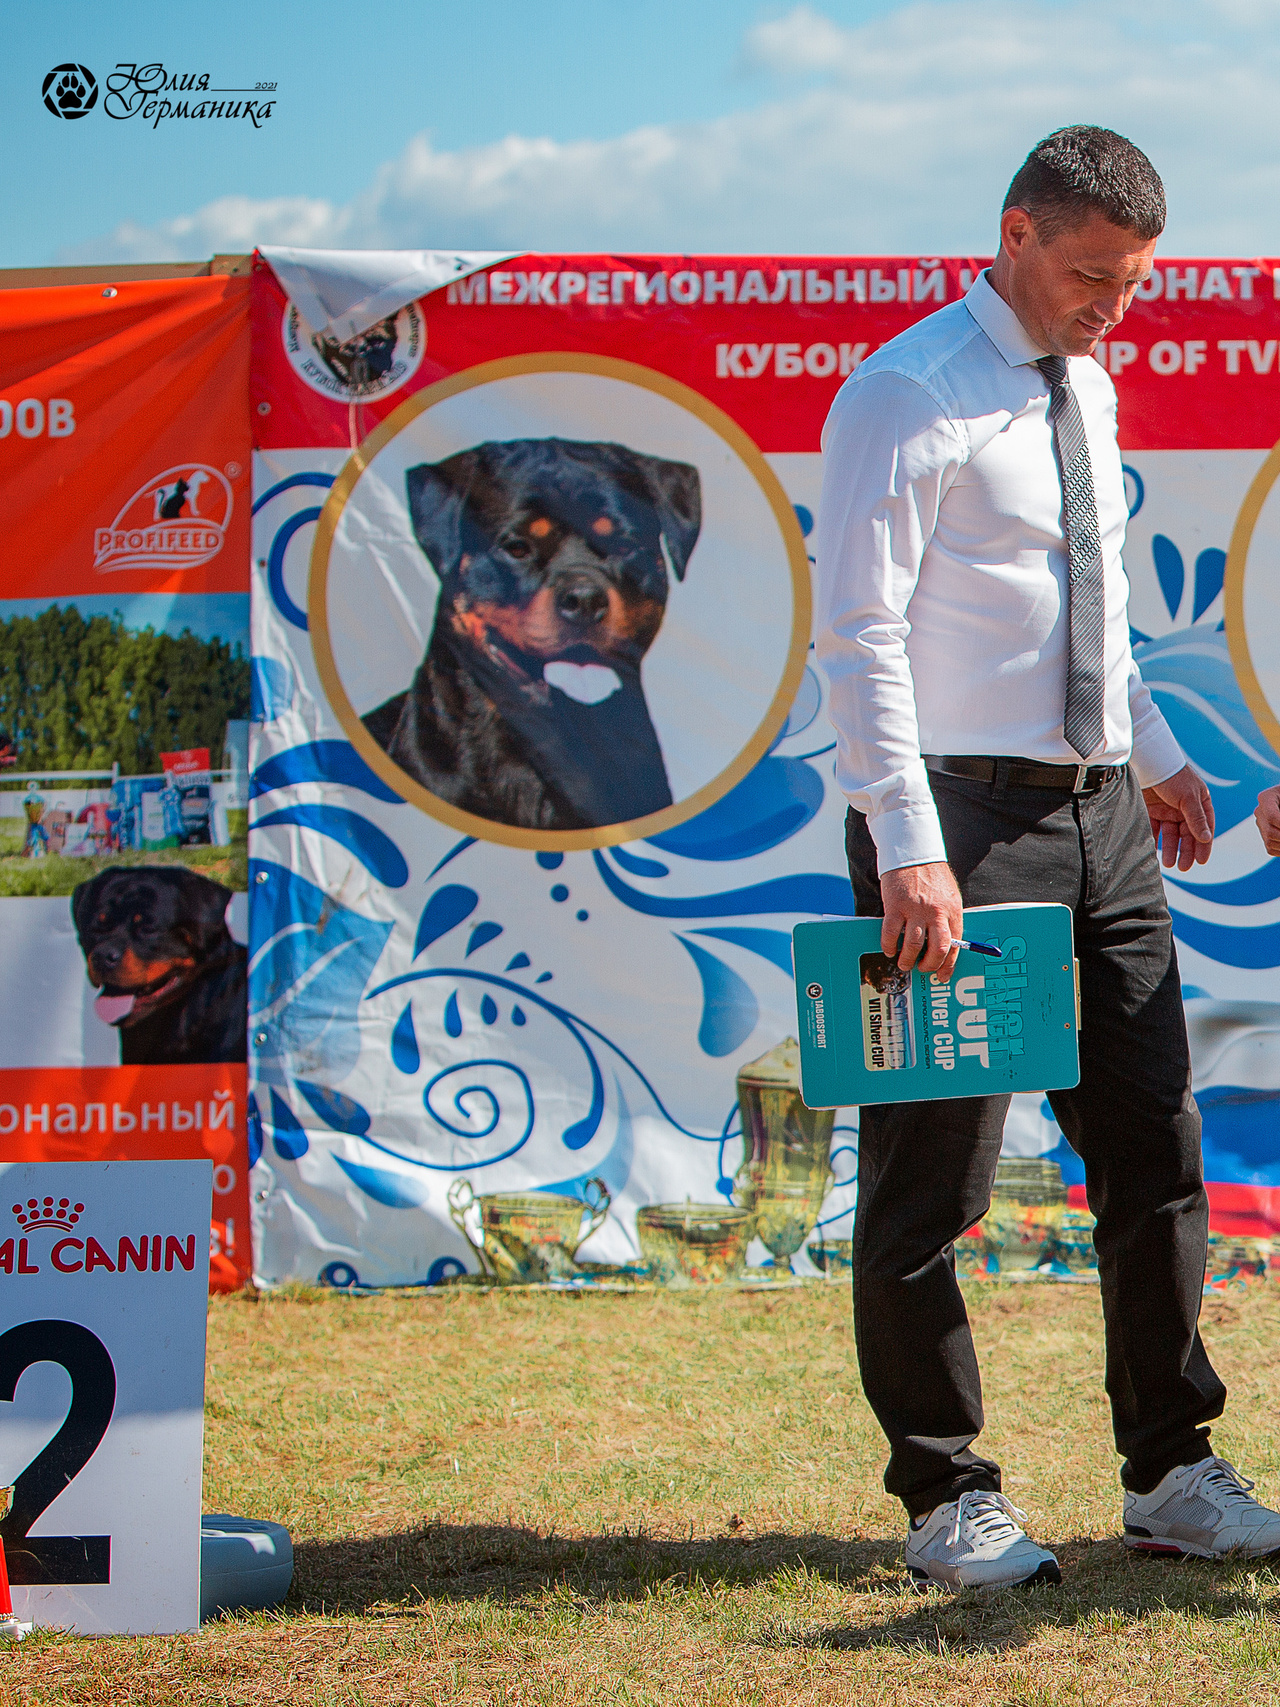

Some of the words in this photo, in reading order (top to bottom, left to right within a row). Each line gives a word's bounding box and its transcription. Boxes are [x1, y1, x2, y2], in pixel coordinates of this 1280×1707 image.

[446, 258, 946, 306] МЕЖРЕГИОНАЛЬНЫЙ
[715, 342, 869, 378] КУБОК
[1149, 339, 1207, 376] OF
[814, 999, 828, 1050] TABOOSPORT
[869, 1013, 882, 1047] Silver
[871, 1046, 885, 1069] CUP
[932, 1032, 956, 1072] CUP
[50, 1233, 197, 1275] CANIN
[0, 1318, 117, 1585] 2
